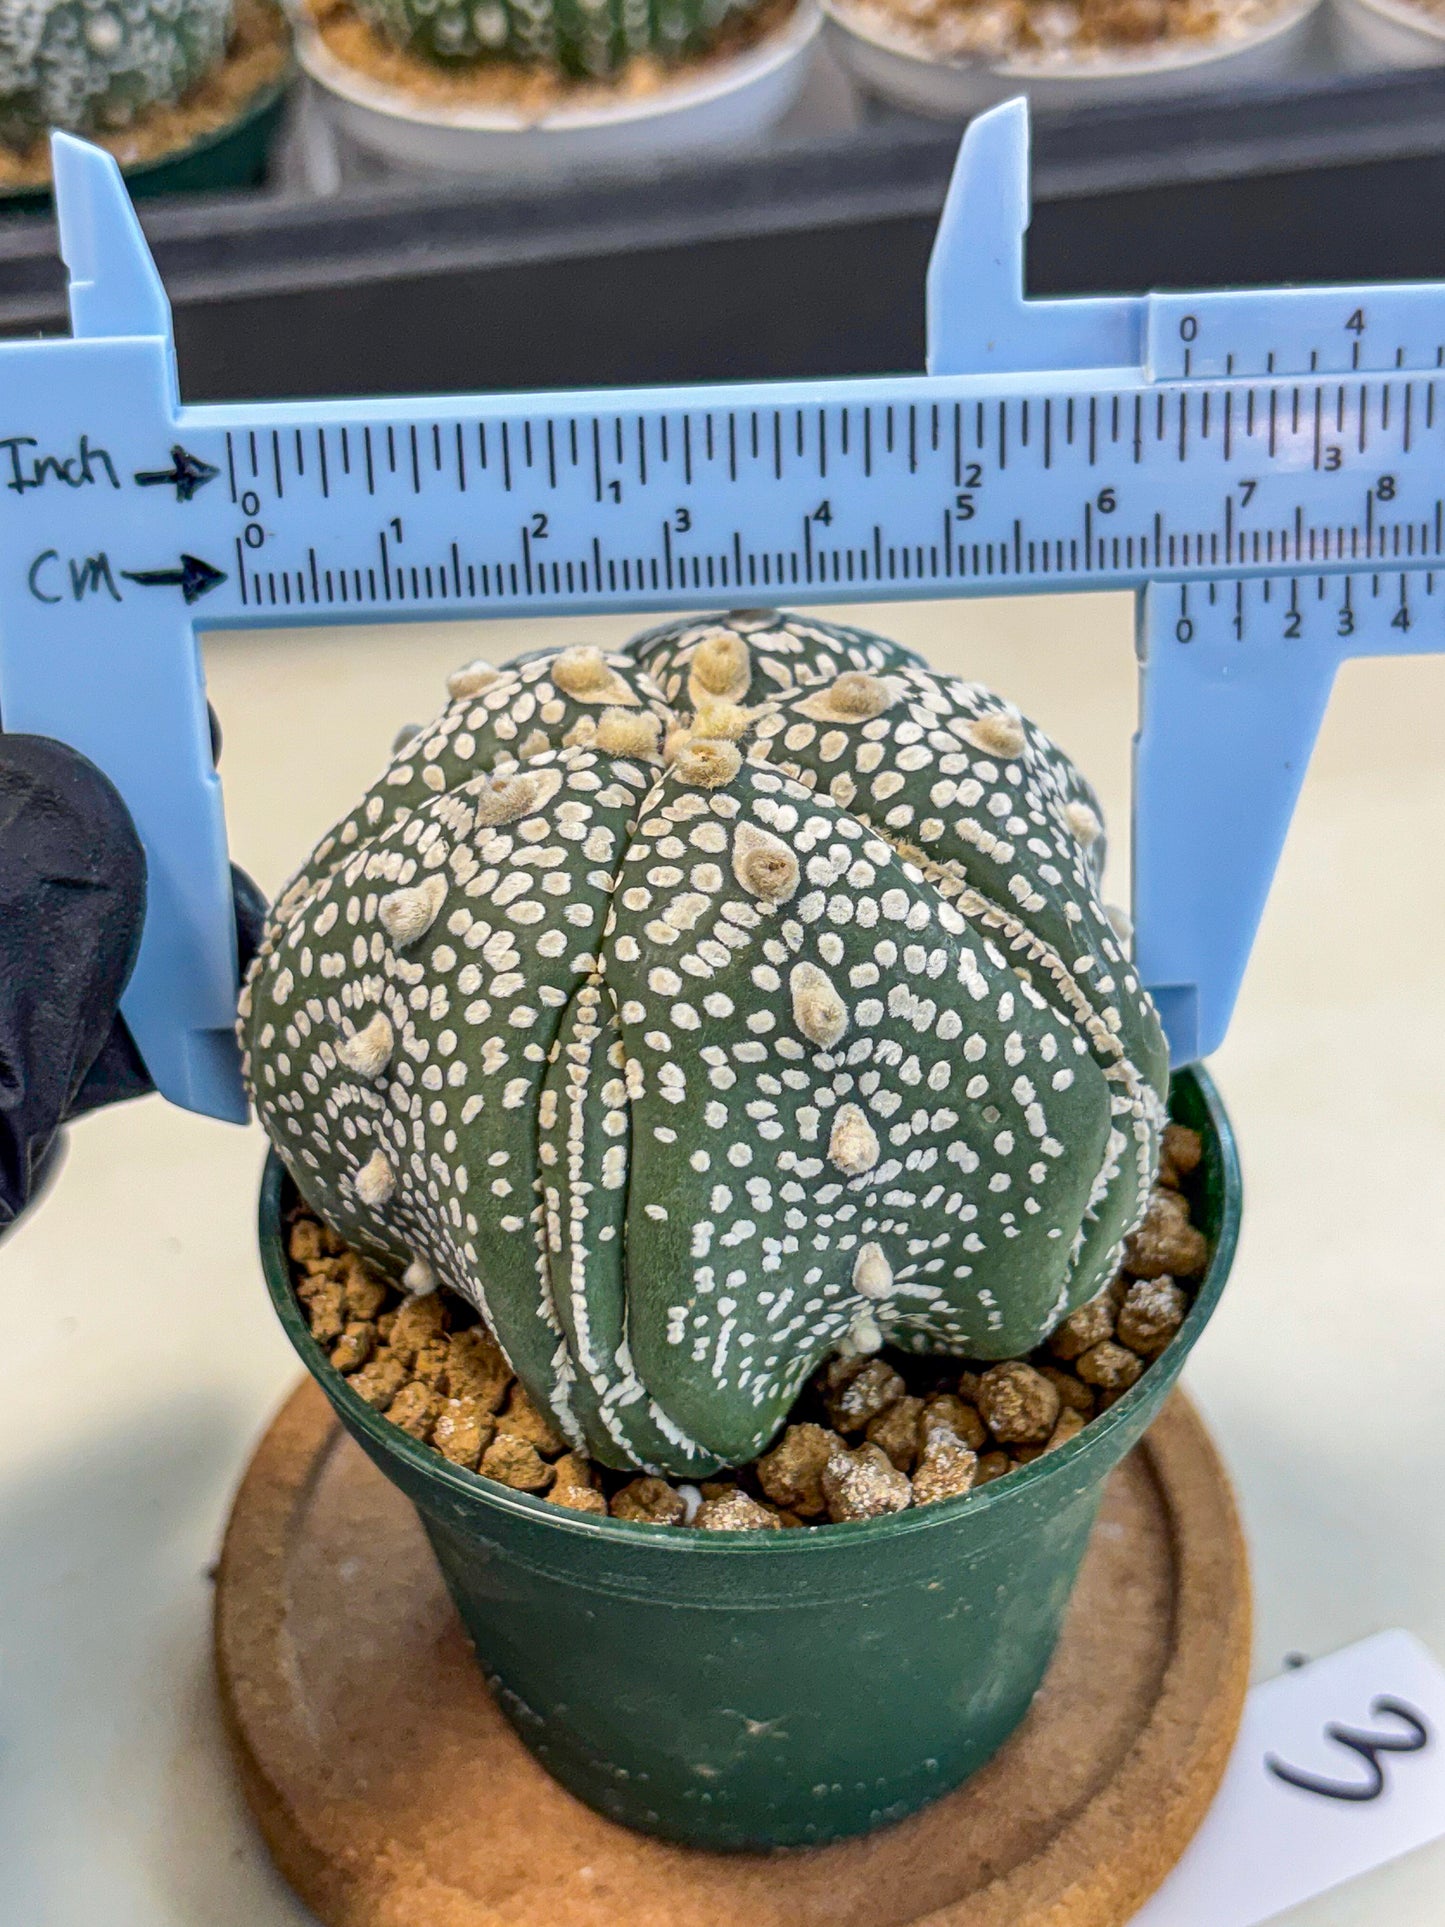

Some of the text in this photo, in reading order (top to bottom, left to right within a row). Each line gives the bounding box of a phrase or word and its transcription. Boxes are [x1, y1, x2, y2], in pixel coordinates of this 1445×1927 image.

[1180, 309, 1366, 342] 0 4
[0, 434, 121, 495] Inch
[241, 447, 1342, 516] 0 1 2 3
[244, 476, 1396, 548] 0 1 2 3 4 5 6 7 8
[1176, 607, 1410, 643] 0 1 2 3 4
